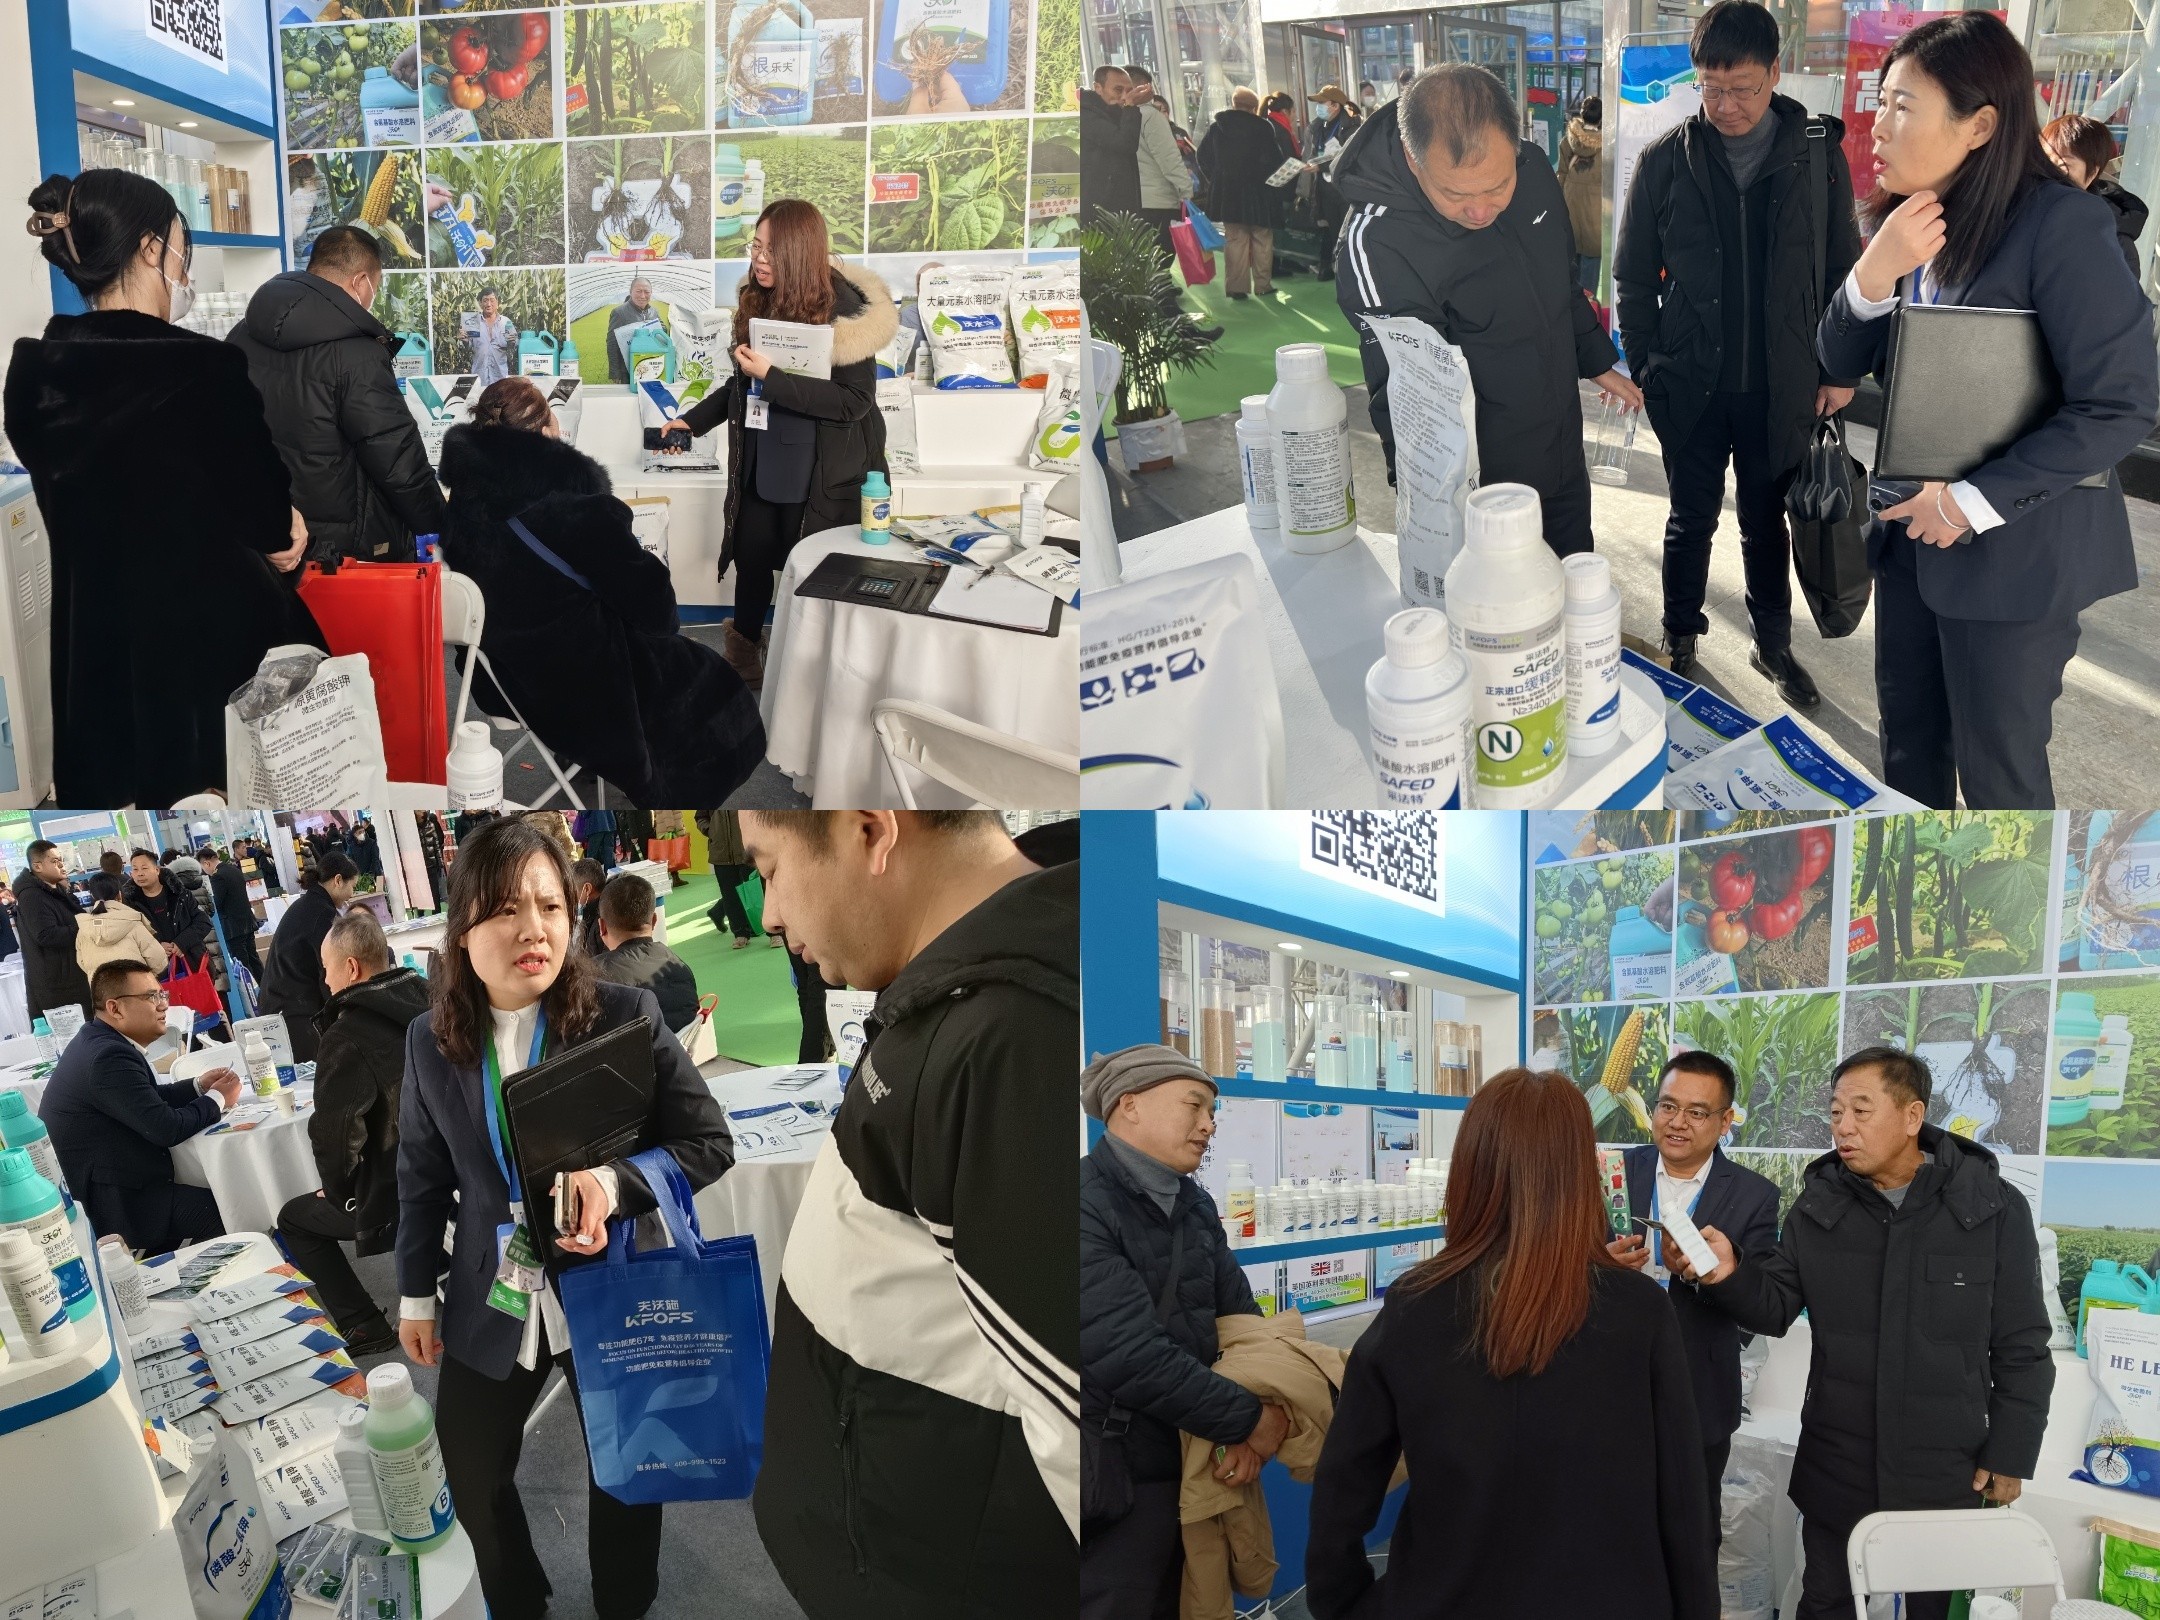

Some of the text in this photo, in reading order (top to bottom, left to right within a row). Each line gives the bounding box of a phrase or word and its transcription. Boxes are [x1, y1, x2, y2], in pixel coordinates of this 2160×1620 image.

[754, 57, 793, 73] 根乐夫
[927, 294, 1002, 307] 大量元素水溶肥料
[1388, 331, 1420, 348] KFOFS
[1513, 650, 1559, 678] SAFED
[286, 674, 351, 714] 源黄腐酸钾
[1485, 685, 1524, 695] 正宗进口
[1513, 695, 1558, 716] N≥340g/L
[1488, 730, 1513, 754] N
[1380, 772, 1435, 791] SAFED
[1740, 774, 1788, 810] 酸二氢钾
[2122, 865, 2160, 890] 根
[1622, 966, 1667, 976] 含氨基酸水溶肥料
[41, 1228, 62, 1245] 沃叶
[638, 1300, 680, 1312] 夫沃施
[626, 1311, 694, 1328] KFOFS
[626, 1352, 655, 1361] NUTRITION
[637, 1344, 672, 1352] FUNCTIONAL
[2110, 1355, 2135, 1371] HE
[674, 1458, 726, 1467] 400-999-1523
[284, 1465, 318, 1507] 磷酸二氢钾
[310, 1476, 328, 1496] SAFED
[189, 1494, 209, 1525] KFOF
[440, 1492, 449, 1510] B
[276, 1500, 291, 1521] KFOFS
[2124, 1570, 2160, 1582] KFOFS
